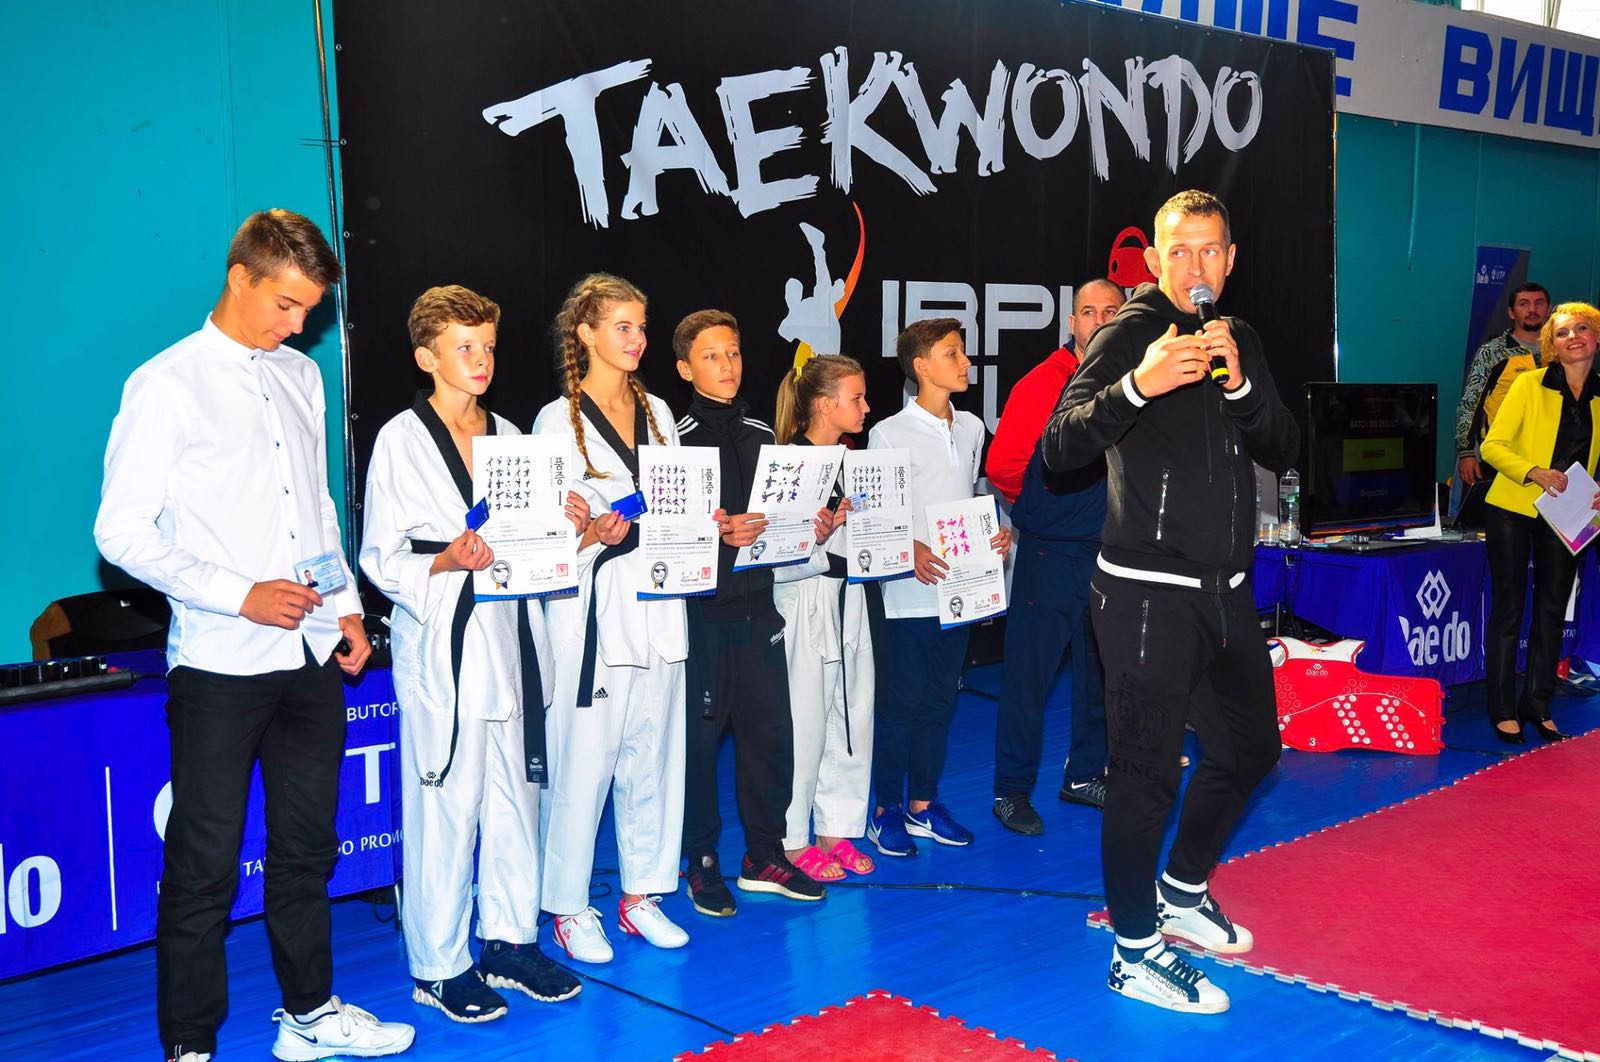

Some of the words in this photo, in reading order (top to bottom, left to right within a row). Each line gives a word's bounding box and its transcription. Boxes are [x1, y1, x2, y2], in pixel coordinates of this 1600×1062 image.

[1439, 25, 1600, 137] ВИЩ
[482, 46, 1264, 228] TAEKWONDO
[882, 280, 1073, 358] IRPI
[1309, 737, 1317, 747] 3
